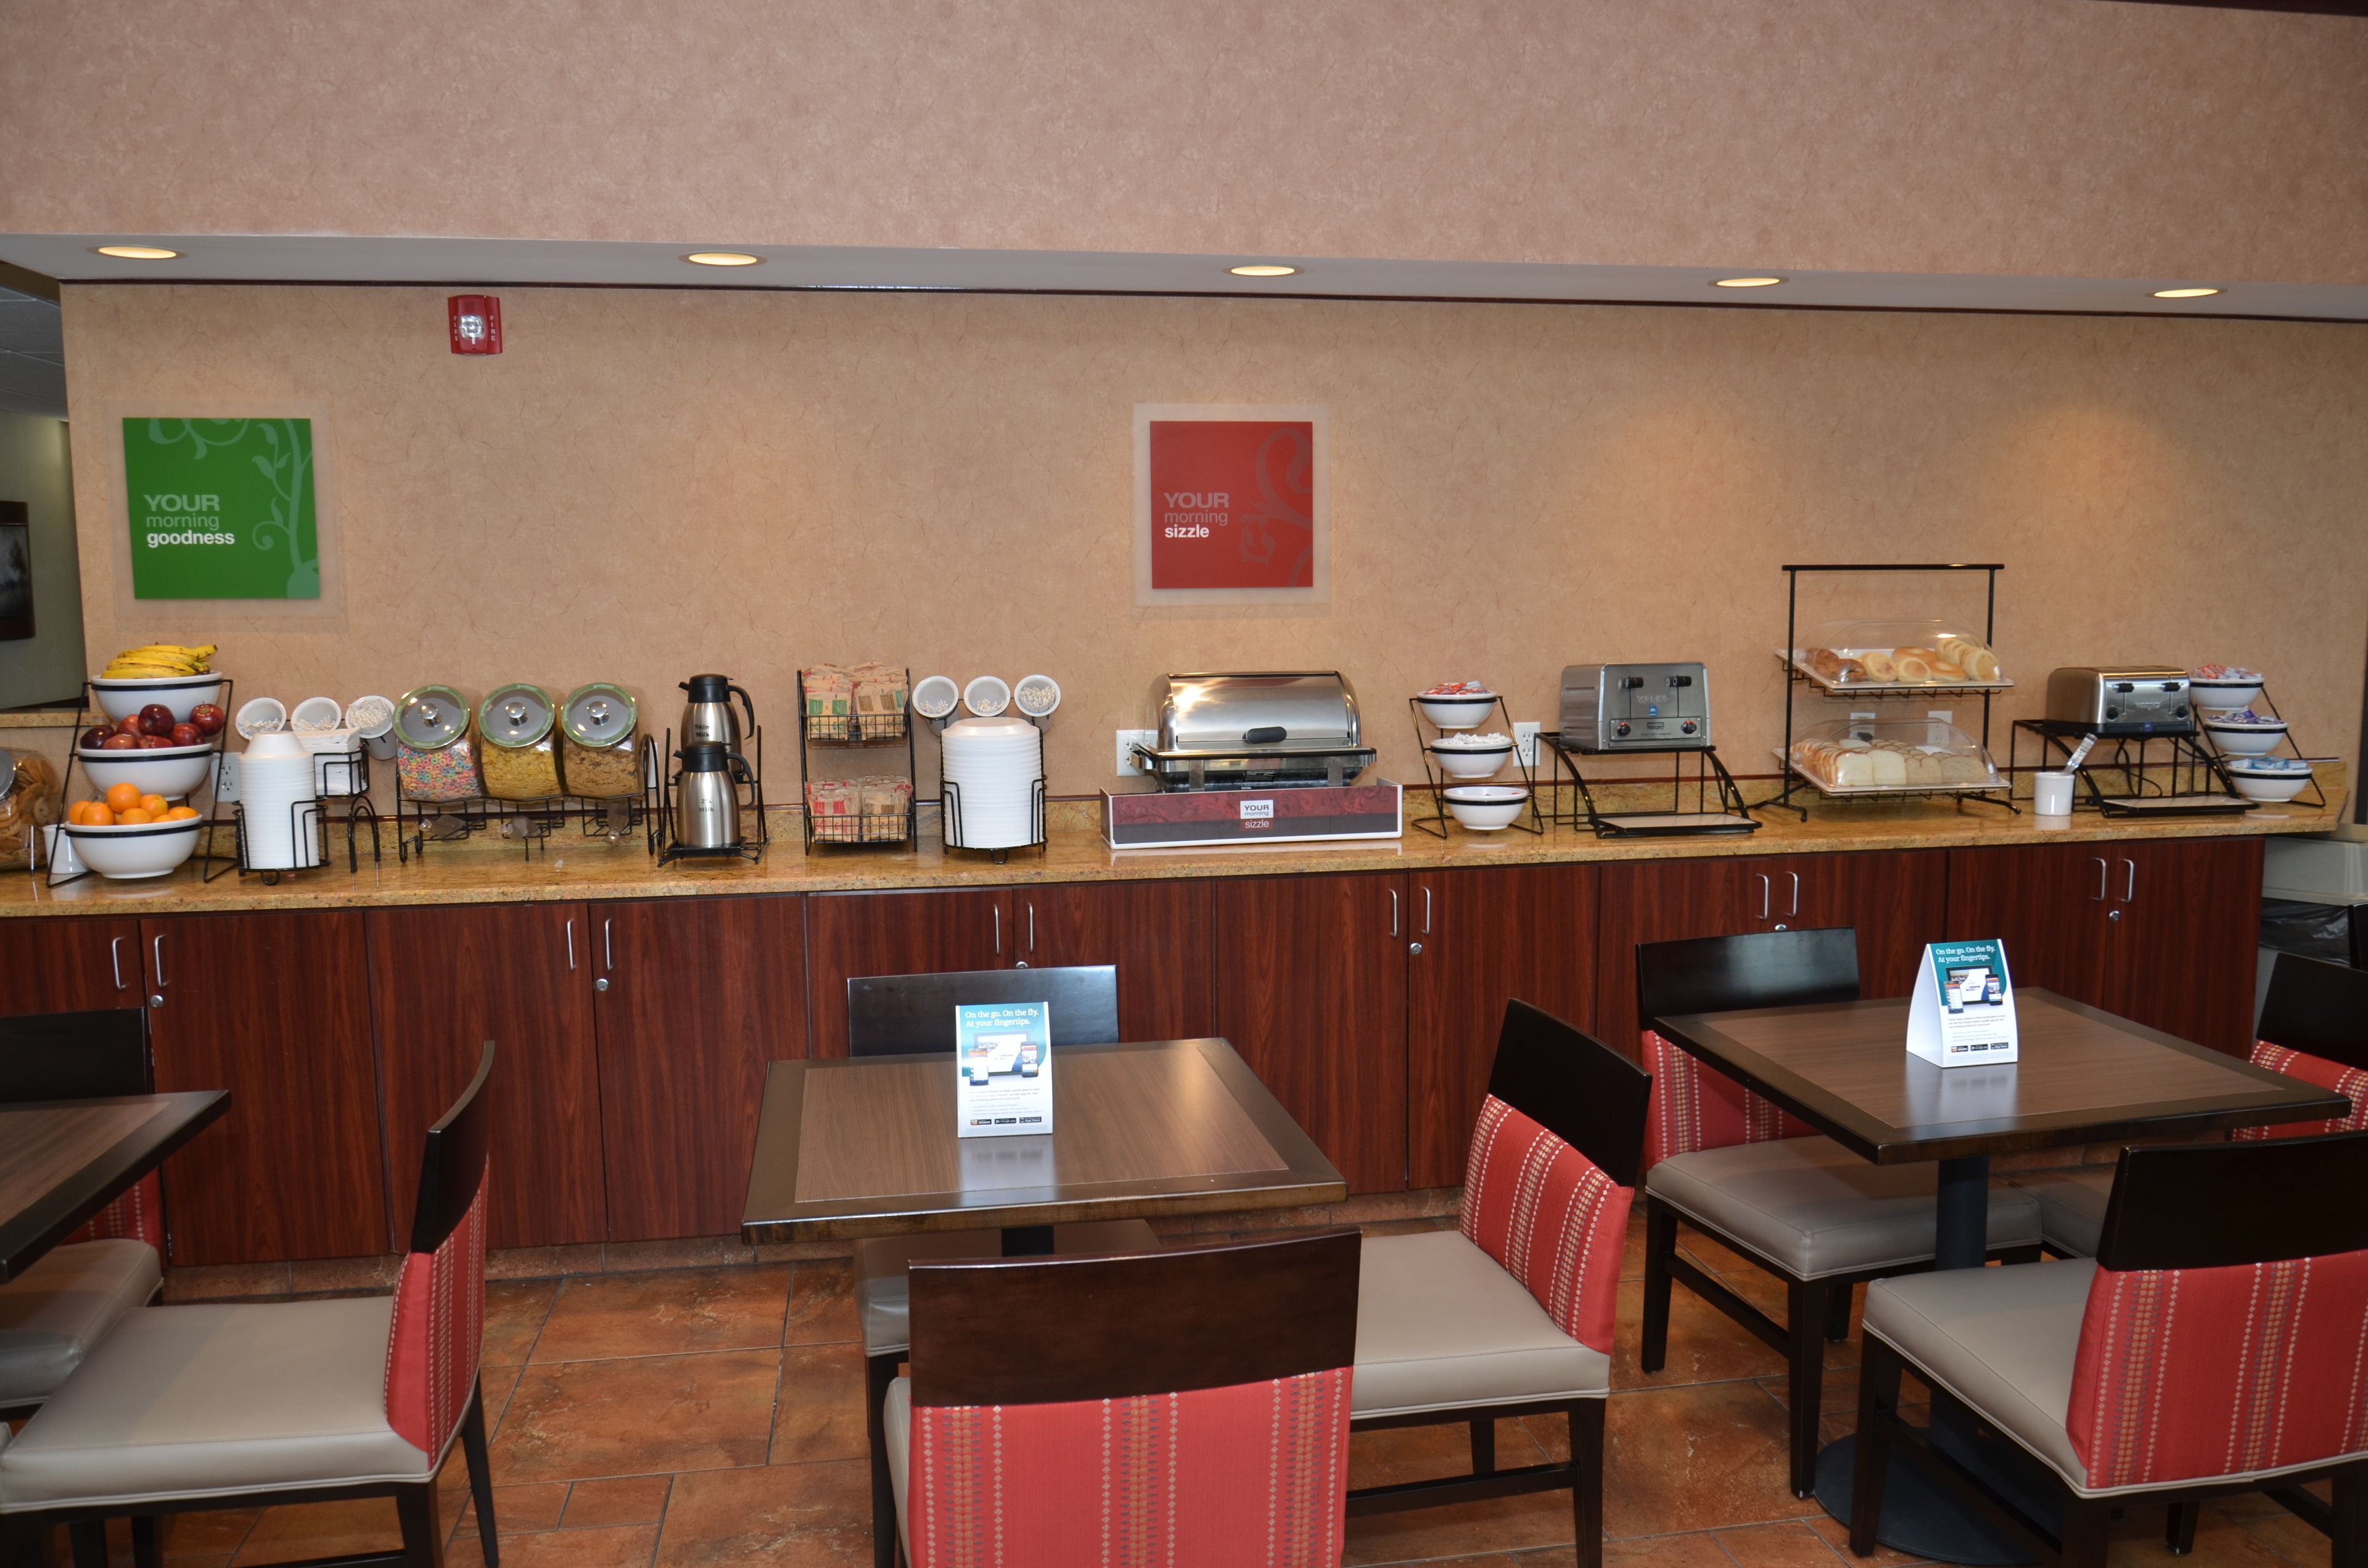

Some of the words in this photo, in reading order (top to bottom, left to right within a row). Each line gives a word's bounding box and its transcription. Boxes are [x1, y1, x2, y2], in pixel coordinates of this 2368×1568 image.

[144, 495, 220, 512] YOUR
[1164, 492, 1230, 509] YOUR
[146, 513, 220, 531] morning
[1164, 509, 1228, 527] morning
[1164, 524, 1210, 538] sizzle
[147, 530, 235, 548] goodness
[1245, 819, 1269, 829] sizzle
[1986, 945, 1996, 953] fly.
[1960, 954, 1991, 963] fingertips.
[1028, 1008, 1039, 1017] fly.
[975, 1020, 993, 1028] your
[994, 1018, 1031, 1027] fingertips.
